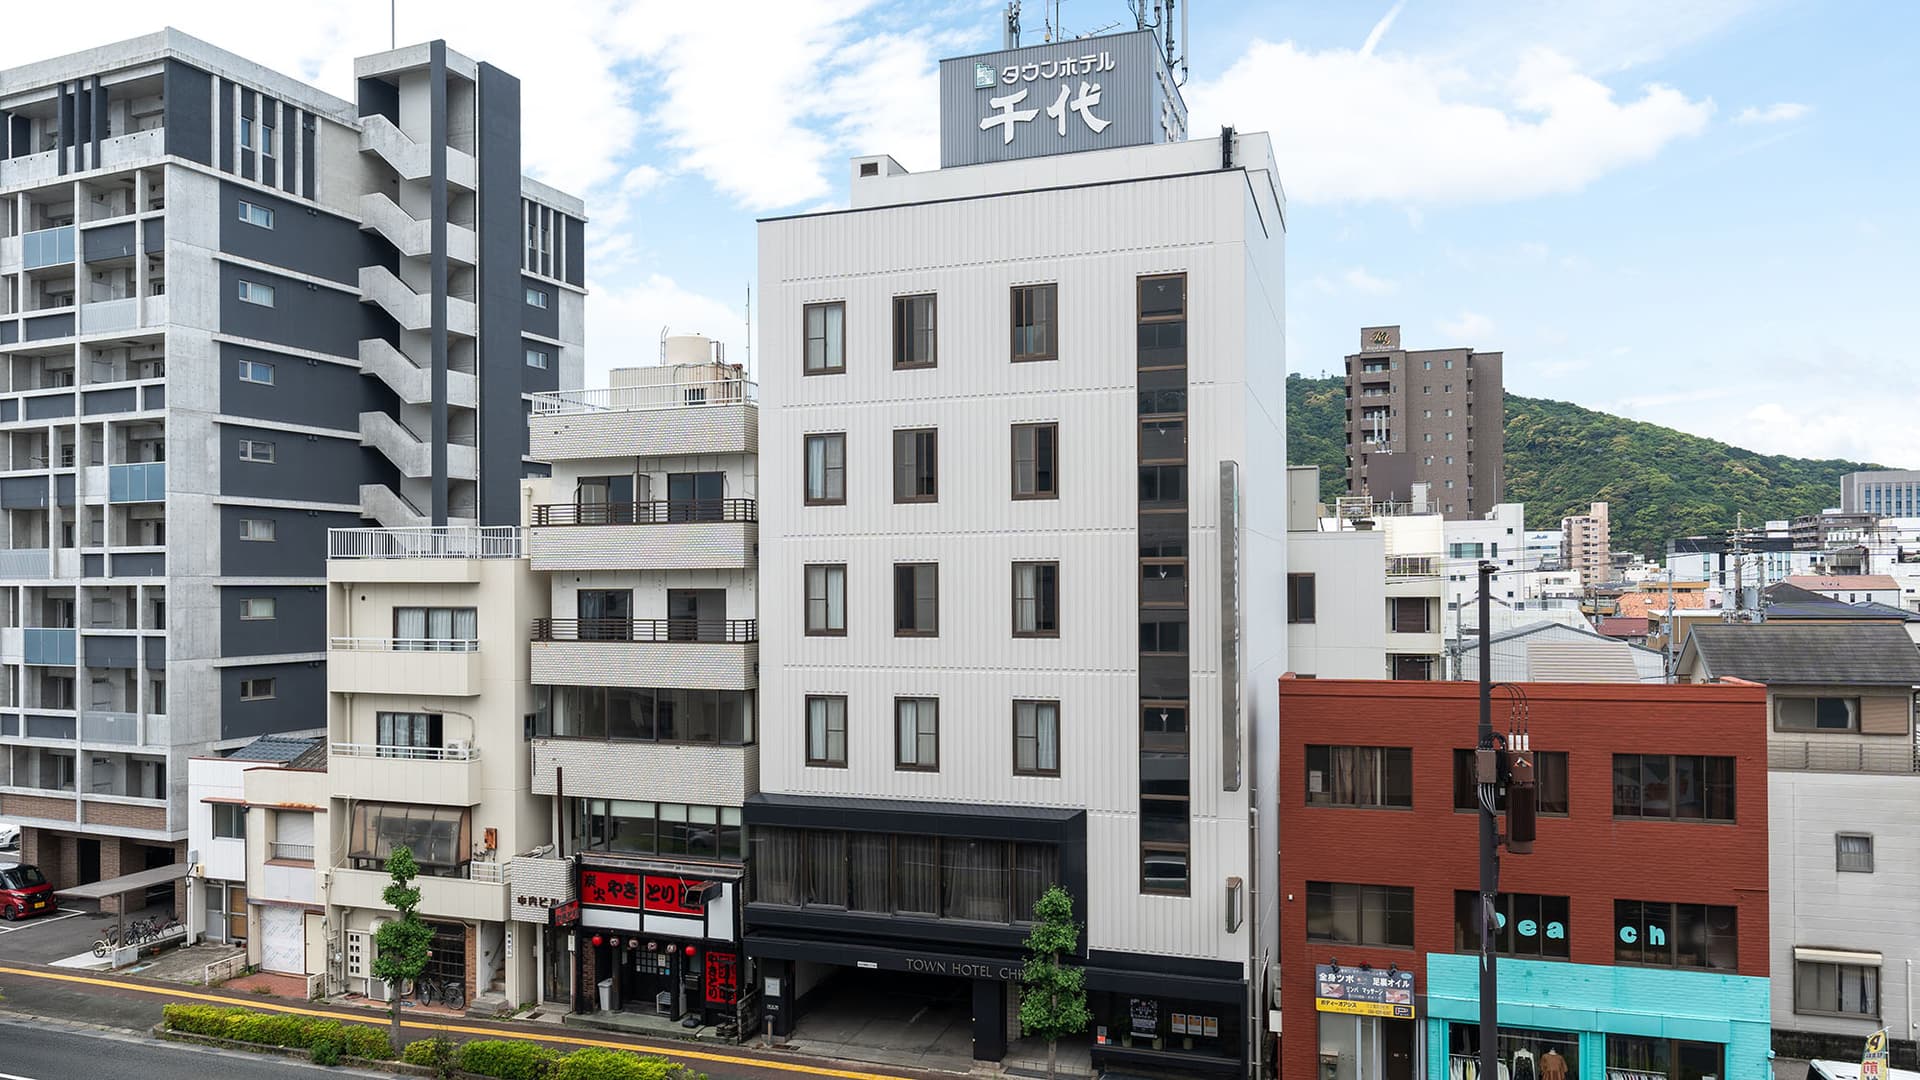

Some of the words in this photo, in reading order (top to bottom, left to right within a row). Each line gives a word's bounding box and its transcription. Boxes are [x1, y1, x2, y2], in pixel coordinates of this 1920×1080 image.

[1002, 51, 1115, 84] タウンホテル
[979, 81, 1112, 145] 千代
[607, 880, 675, 904] やきとり
[906, 958, 946, 973] TOWN
[952, 963, 993, 978] HOTEL
